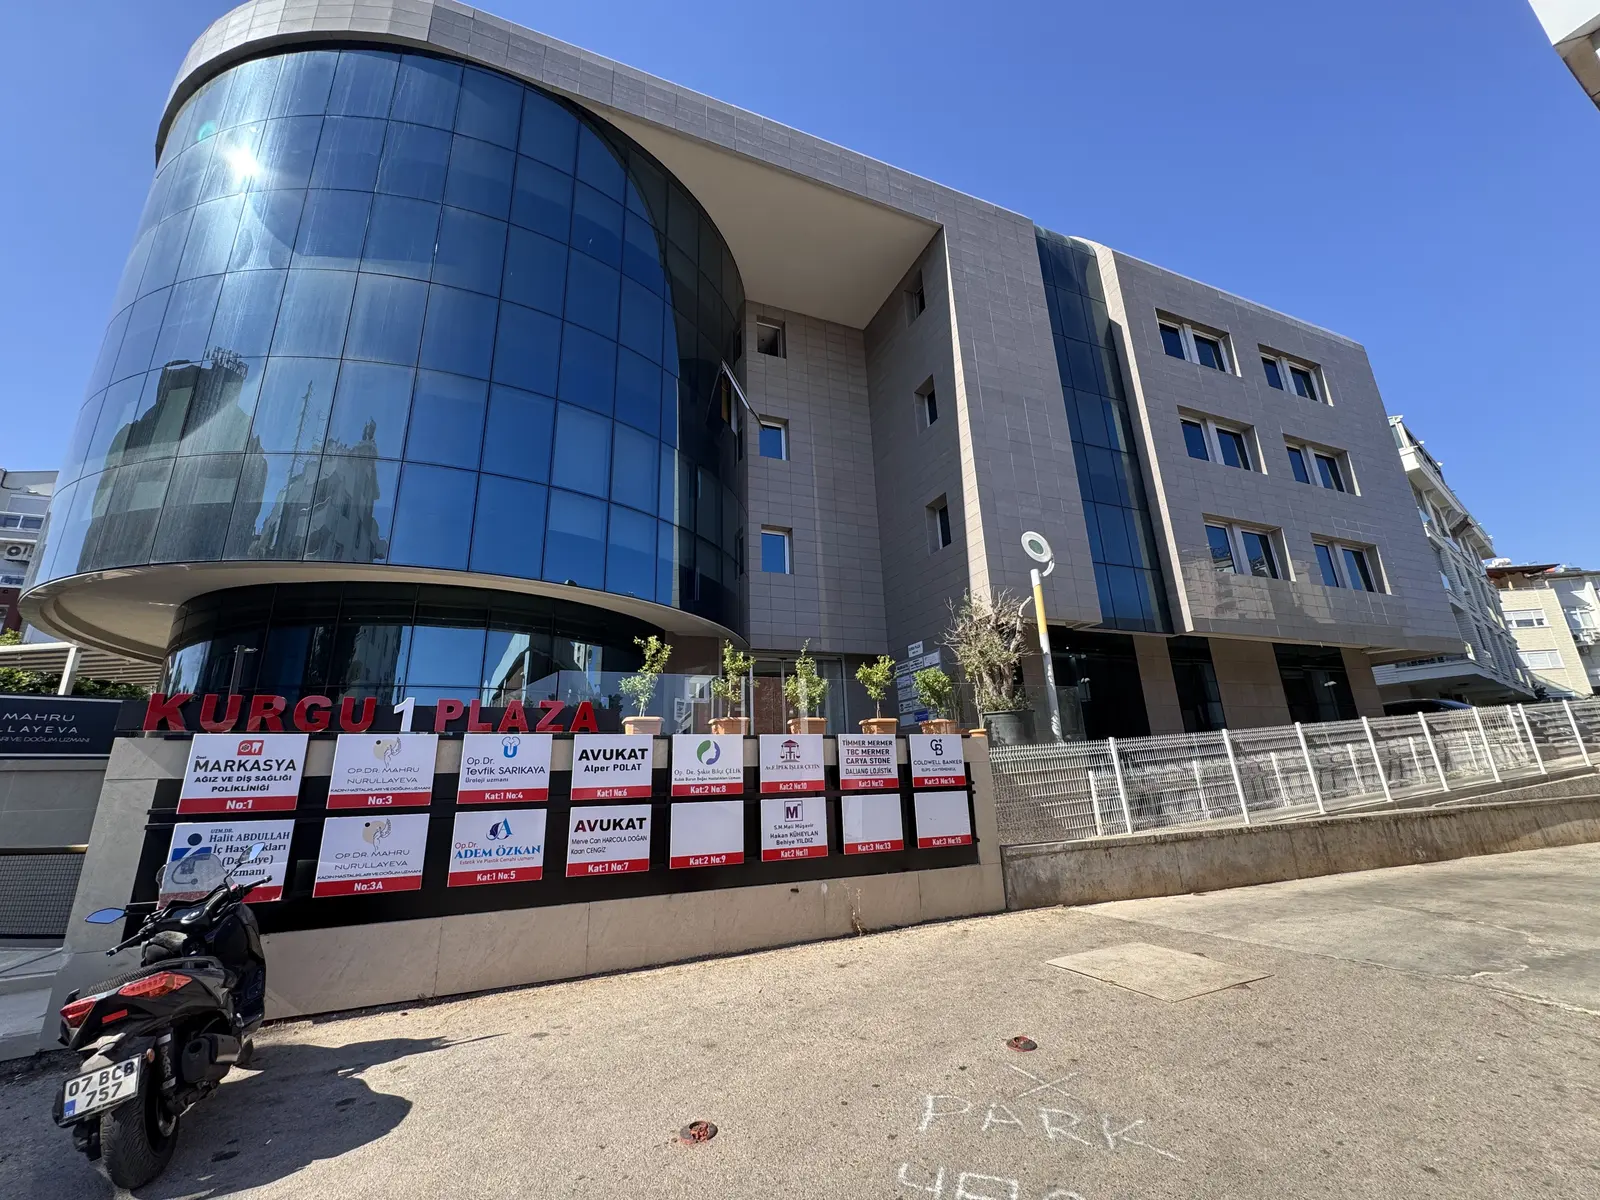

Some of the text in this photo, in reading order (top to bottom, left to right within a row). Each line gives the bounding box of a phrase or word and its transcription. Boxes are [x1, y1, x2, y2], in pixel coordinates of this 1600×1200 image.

[2, 713, 75, 722] MAHRU
[143, 693, 599, 732] KURGU 1 PLAZA
[0, 726, 78, 734] LAYEVA
[578, 748, 649, 761] AVUKAT
[846, 748, 860, 756] TBC
[193, 759, 297, 773] MARKASYA
[467, 757, 495, 766] Op.Dr.
[466, 766, 546, 775] Tevfik SARIKAYA
[584, 763, 642, 774] Alper POLAT
[236, 775, 252, 783] DİŞ
[211, 784, 270, 792] POLİKLİNİĞİ
[690, 785, 727, 794] Kat:2 No:8
[368, 796, 393, 805] No:3
[485, 792, 504, 800] Kat:1
[226, 800, 253, 810] No:1
[574, 817, 647, 832] AVUKAT
[209, 832, 290, 843] Halit ABDULLAH
[628, 834, 648, 842] DOĞAN
[932, 838, 947, 846] Kat:3
[213, 843, 287, 855] İç Haskları
[454, 842, 478, 850] Op.Dr.
[586, 846, 606, 854] CENGİZ
[857, 843, 874, 852] Kat:3
[371, 849, 410, 858] MAHRU
[454, 845, 542, 859] ADEM ÖZKAN
[334, 860, 408, 870] NURULLAYEVA
[689, 855, 726, 866] Kat:2 No:9
[588, 862, 629, 873] Kat:1 No:7
[477, 872, 496, 882] Kat:1
[354, 881, 383, 891] No:3A
[68, 1076, 93, 1097] 07
[85, 1081, 123, 1108] 757
[919, 1094, 1185, 1162] PARK
